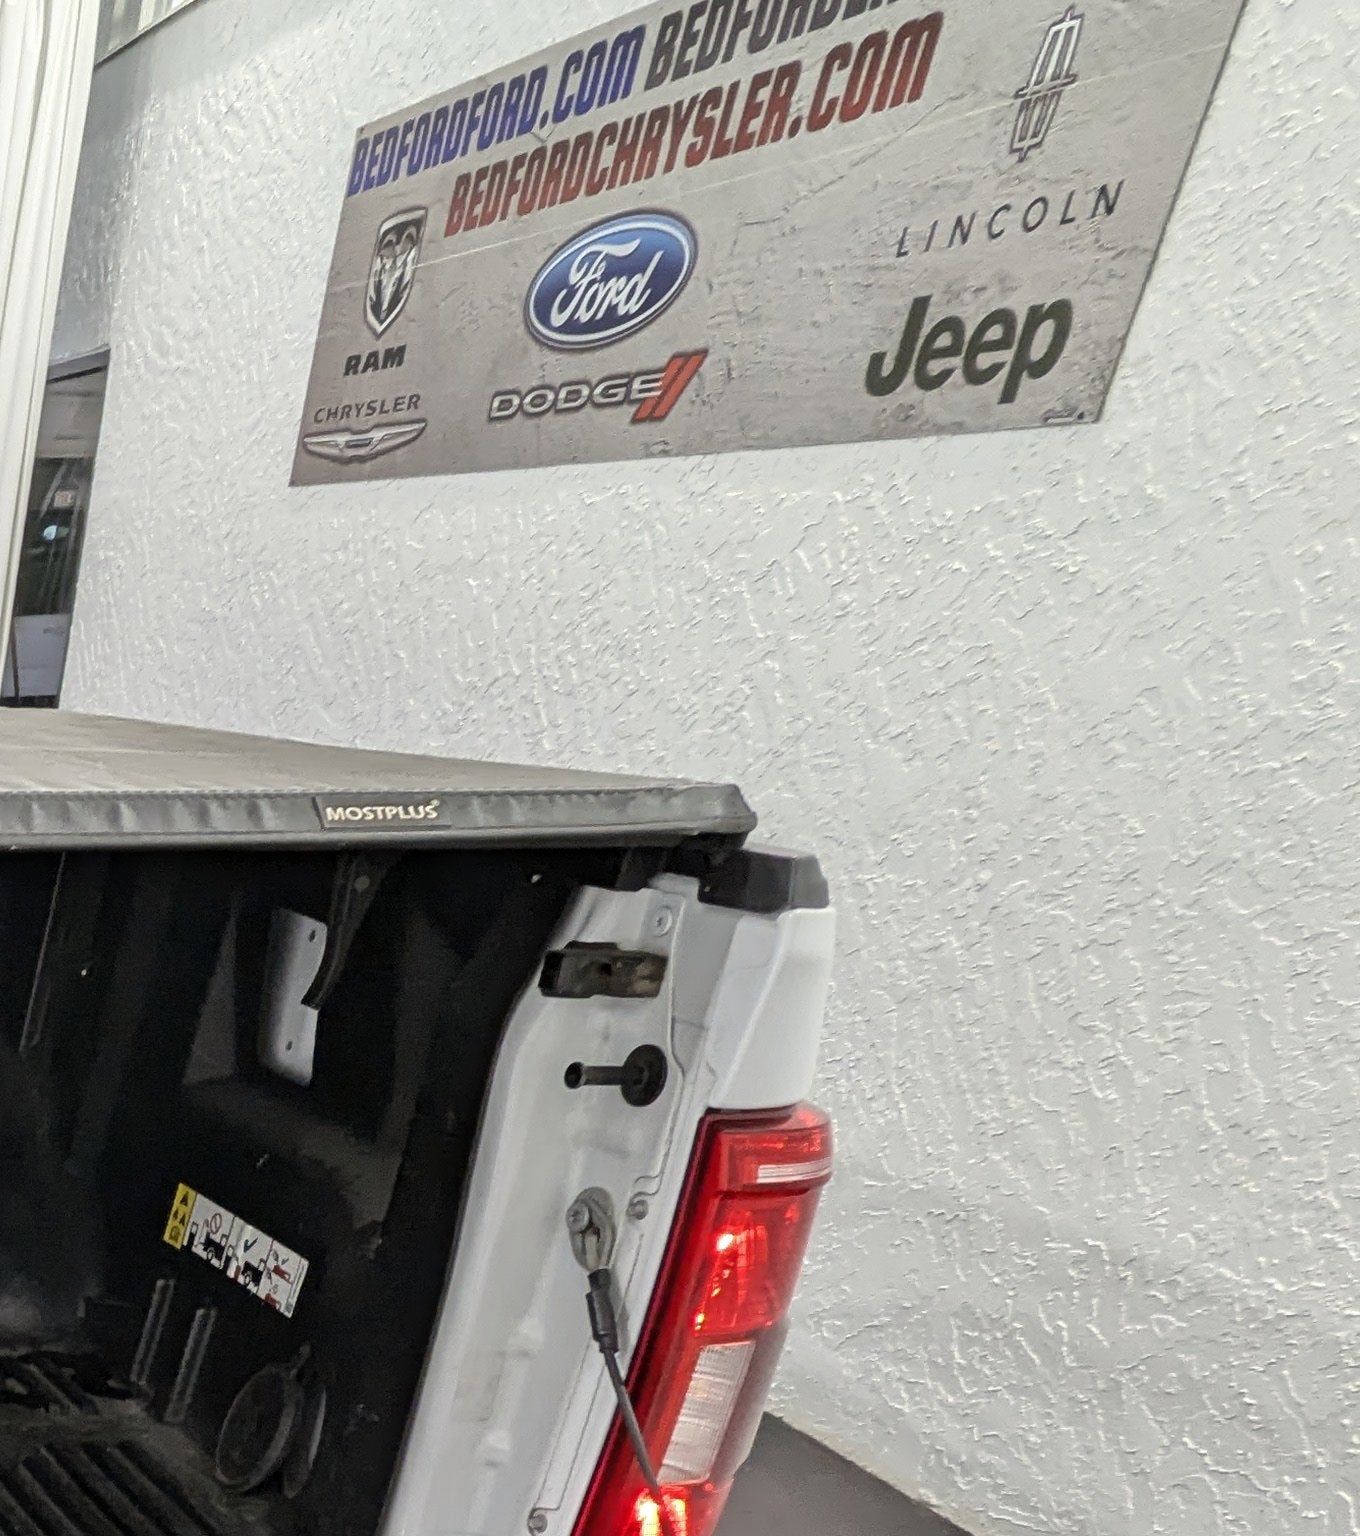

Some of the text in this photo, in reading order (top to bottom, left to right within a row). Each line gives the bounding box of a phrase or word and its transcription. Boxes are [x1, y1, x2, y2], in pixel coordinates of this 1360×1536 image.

[347, 23, 647, 198] BEDFORDFORD.COM
[444, 11, 945, 238] BEDFORDCHRYSLER.COM
[895, 179, 1125, 258] LINCOLN
[549, 238, 665, 329] Ford
[343, 344, 407, 377] RAM
[864, 294, 1073, 404] Jeep
[313, 393, 421, 424] CHRYSLER
[488, 370, 666, 422] DODGE
